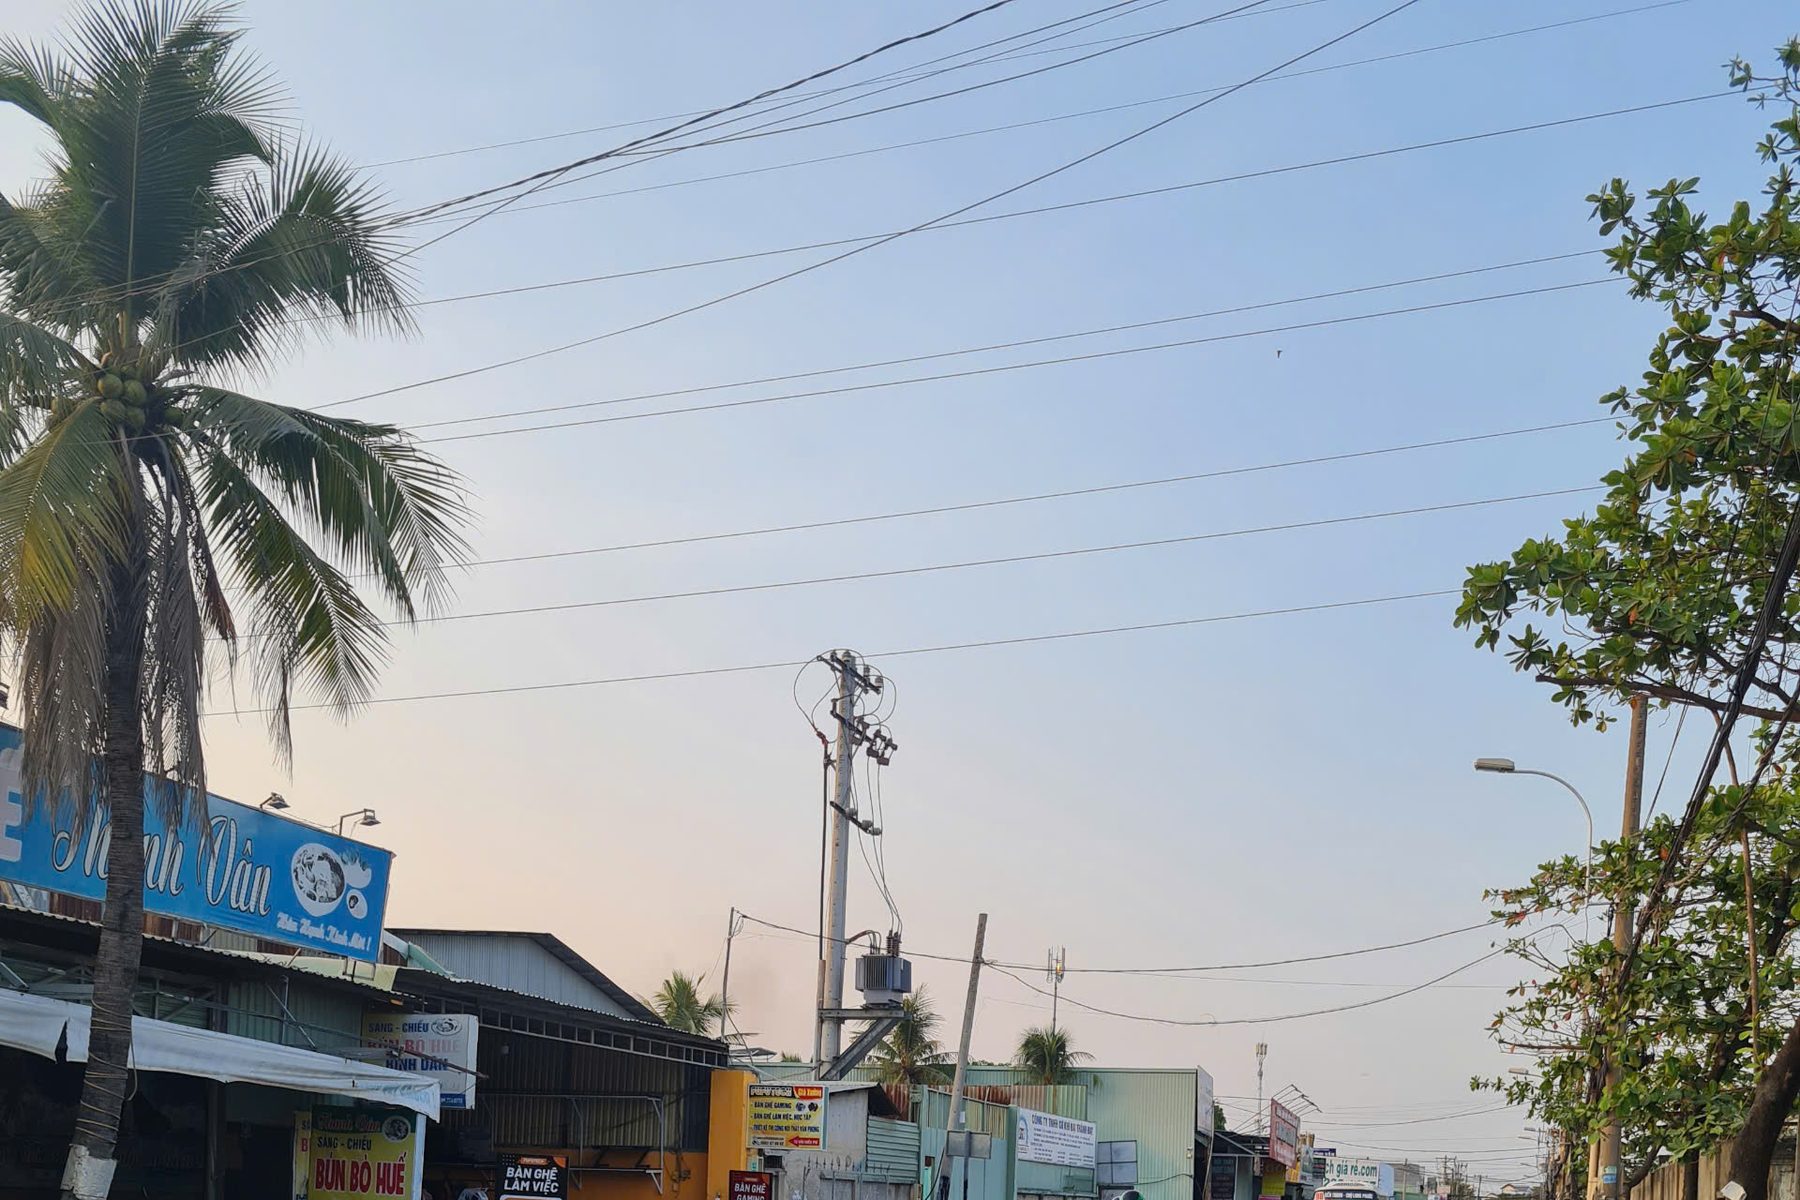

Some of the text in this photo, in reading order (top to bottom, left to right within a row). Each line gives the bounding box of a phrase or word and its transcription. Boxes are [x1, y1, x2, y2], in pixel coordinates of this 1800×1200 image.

[52, 800, 273, 916] Thnh Vân
[315, 1151, 406, 1195] BÚN BÒ HUẾ
[506, 1165, 532, 1179] BÀN
[504, 1178, 559, 1195] LÀM VIỆC
[734, 1182, 750, 1193] BÀN
